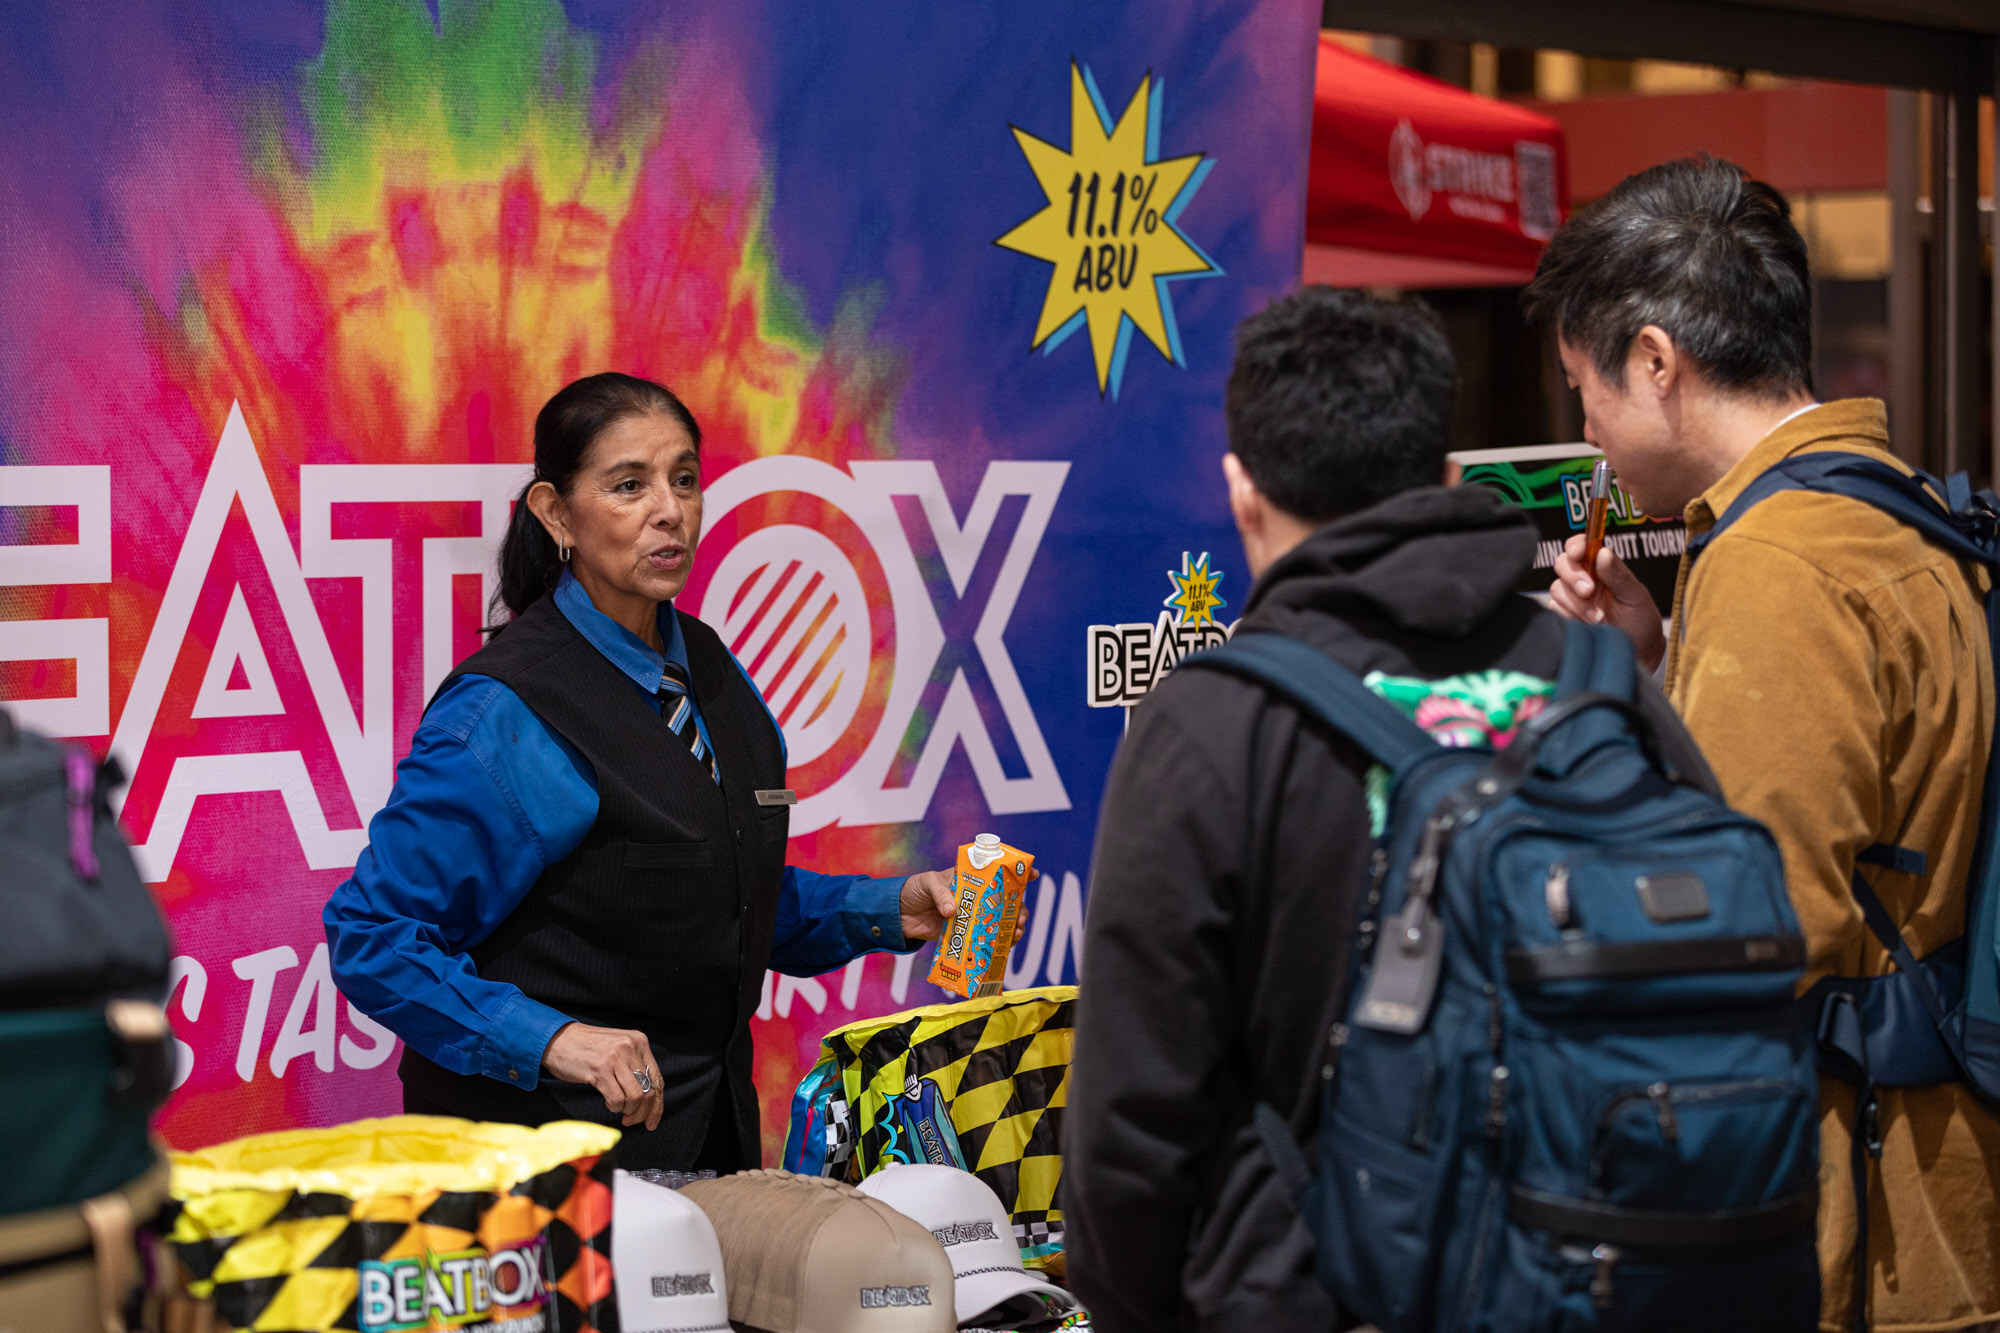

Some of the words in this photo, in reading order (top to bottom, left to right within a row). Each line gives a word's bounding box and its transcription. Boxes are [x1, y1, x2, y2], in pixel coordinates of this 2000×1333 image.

[1067, 171, 1159, 239] 11.1%
[1640, 527, 1687, 558] TOURN
[1188, 582, 1211, 601] 11.1%
[948, 889, 976, 960] BEATBOX
[231, 942, 397, 1083] TAS
[918, 1117, 949, 1166] BEATB
[363, 1243, 547, 1326] BEATBOX
